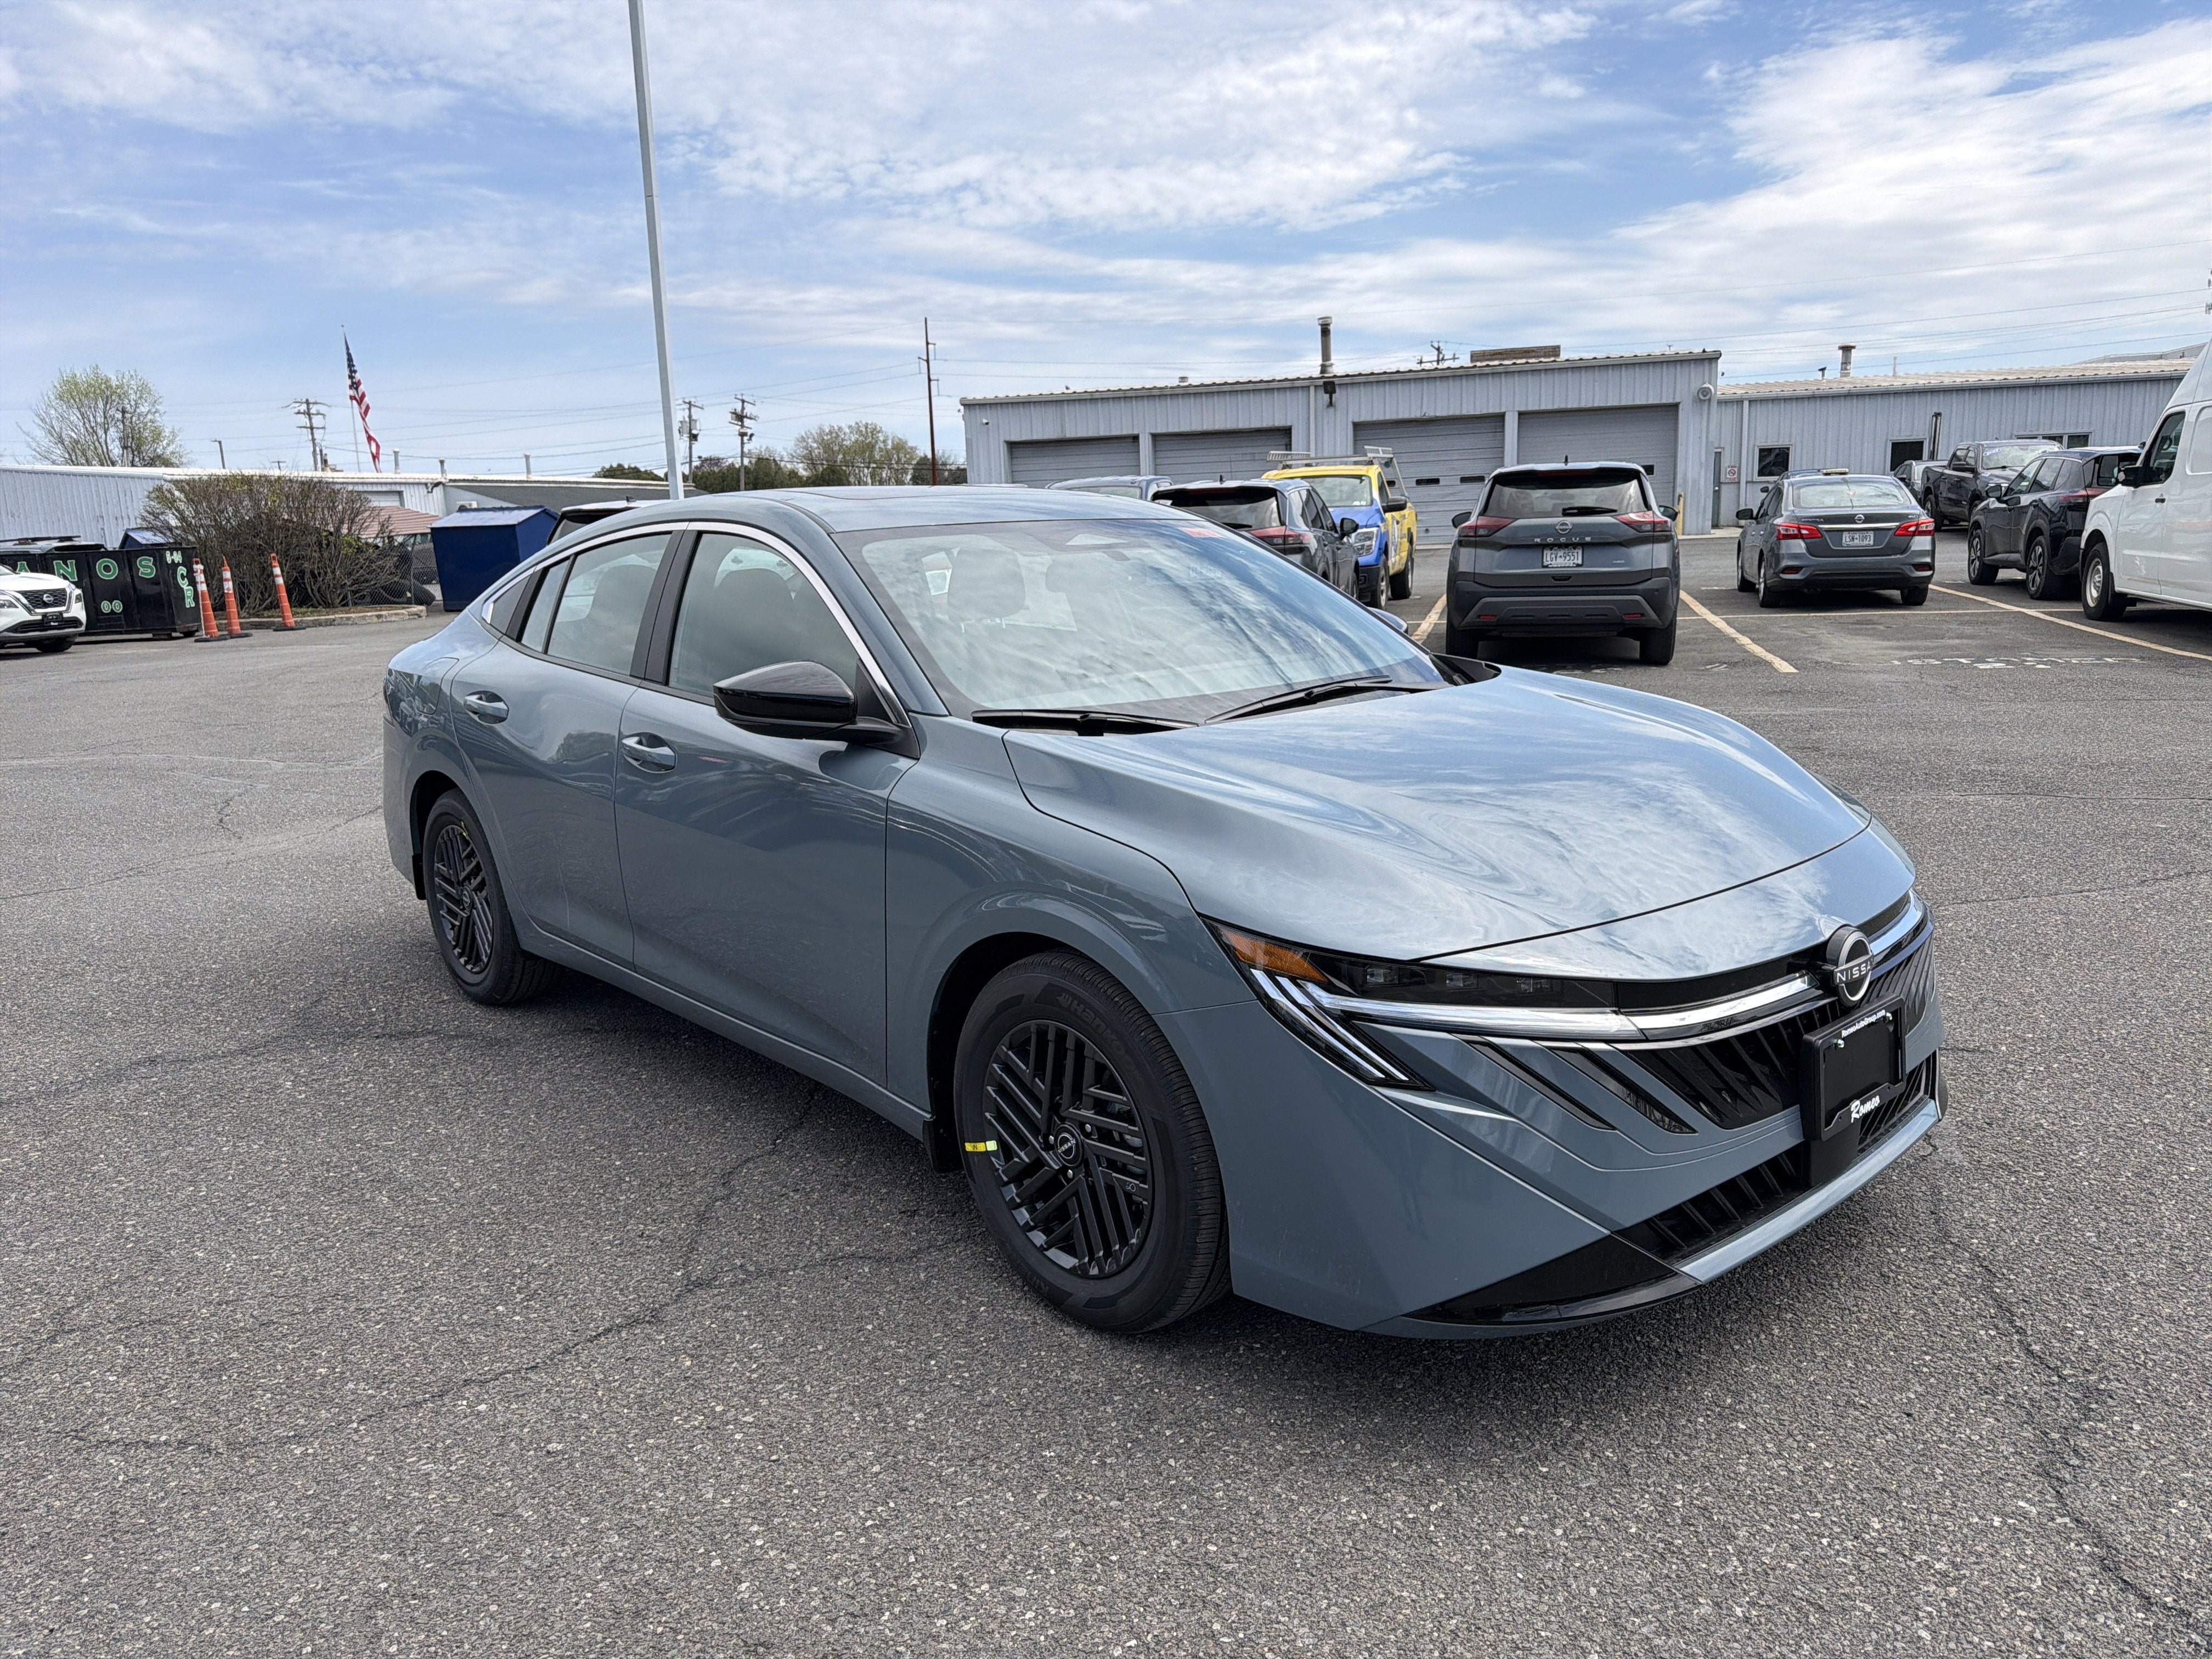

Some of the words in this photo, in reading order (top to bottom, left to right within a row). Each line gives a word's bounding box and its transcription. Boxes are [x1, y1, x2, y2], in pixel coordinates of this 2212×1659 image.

[1859, 534, 1871, 543] 1093
[1545, 551, 1559, 562] LGV
[1562, 551, 1579, 562] 9551
[1850, 1095, 1880, 1124] Romeo
[1058, 1138, 1076, 1154] NISSAN
